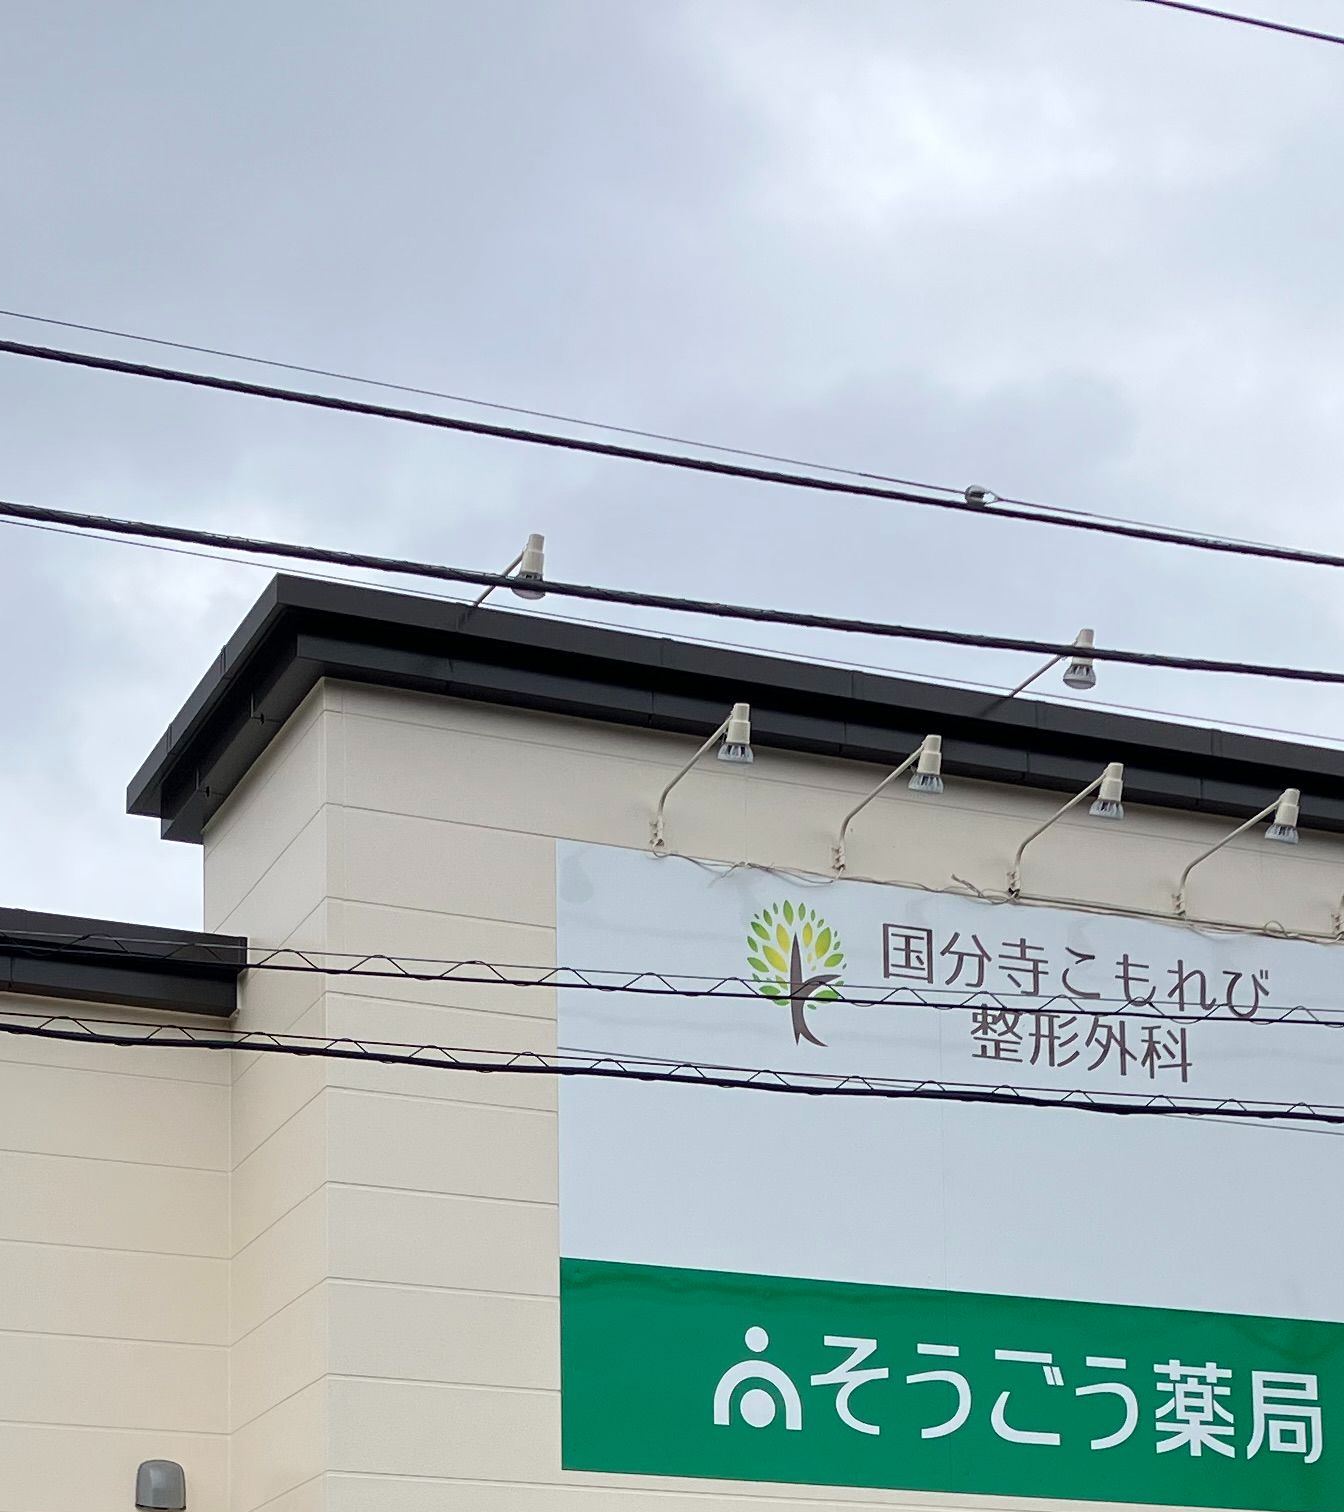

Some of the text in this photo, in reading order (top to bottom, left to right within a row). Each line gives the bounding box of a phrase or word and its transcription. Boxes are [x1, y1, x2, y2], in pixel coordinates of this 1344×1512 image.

[882, 922, 1270, 1019] 国分寺こもれび
[970, 1003, 1193, 1083] 整形外科
[810, 1334, 1325, 1465] そうごう薬局
